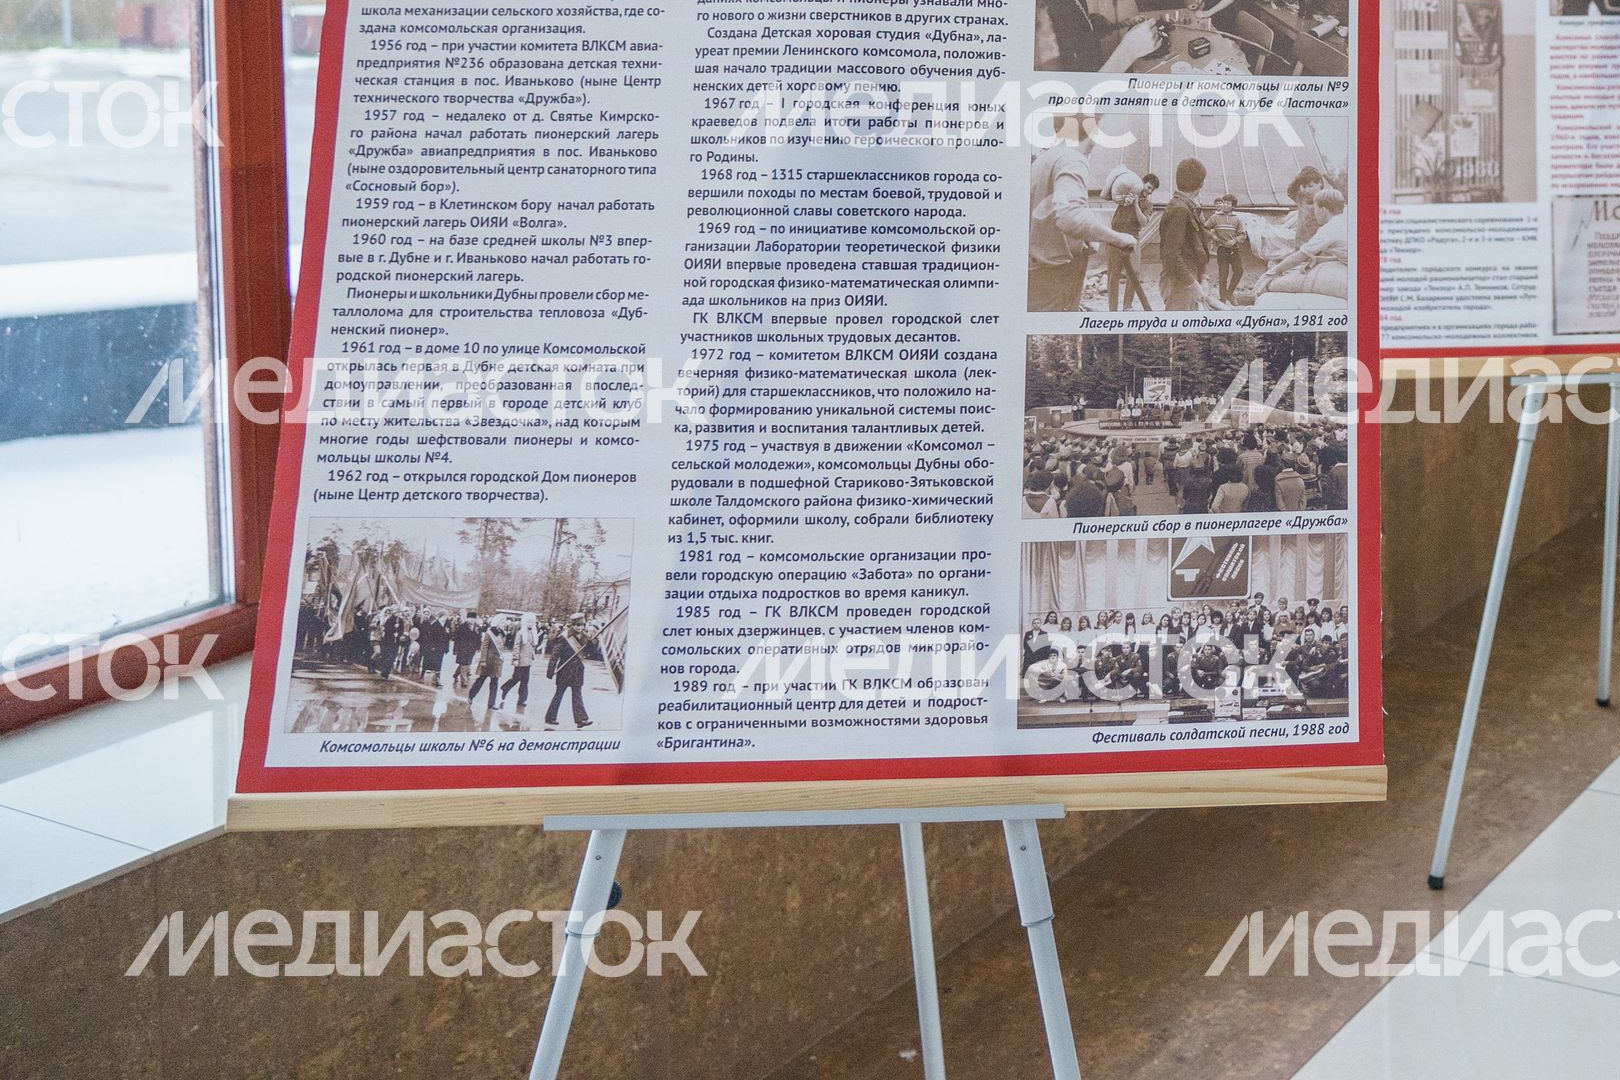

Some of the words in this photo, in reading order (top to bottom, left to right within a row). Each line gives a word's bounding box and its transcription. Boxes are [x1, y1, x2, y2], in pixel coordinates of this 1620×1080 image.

[356, 59, 440, 71] предприятия
[445, 57, 485, 69] №236
[489, 57, 564, 71] образована
[567, 60, 617, 70] детская
[621, 60, 663, 69] техни-
[355, 77, 398, 86] ческая
[403, 77, 455, 87] станция
[461, 77, 468, 86] в
[474, 77, 499, 86] пос.
[505, 75, 574, 87] Иваньково
[580, 75, 618, 89] (ныне
[623, 75, 662, 89] Центр
[1127, 77, 1183, 92] Пионеры
[1197, 82, 1280, 93] комсомольцы
[1283, 83, 1324, 92] школы
[1326, 81, 1349, 92] №9
[1047, 94, 1112, 107] проводят
[1113, 95, 1169, 107] занятие
[1170, 97, 1179, 107] в
[1182, 96, 1235, 108] детском
[1079, 317, 1124, 331] Лагерь
[1127, 316, 1167, 331] труда
[1170, 319, 1179, 328] и
[1182, 316, 1232, 328] отдыха
[1235, 315, 1290, 330] «Дубна»,
[1293, 314, 1323, 326] 1981
[1327, 314, 1348, 326] год
[671, 479, 734, 491] рудовали
[738, 479, 746, 488] в
[750, 476, 830, 491] подшефной
[834, 474, 994, 491] Стариково-Зятьковской
[313, 488, 354, 503] (ныне
[358, 488, 400, 503] Центр
[402, 491, 463, 502] детского
[465, 489, 549, 504] творчества).
[668, 513, 725, 527] кабинет,
[728, 513, 799, 528] оформили
[804, 516, 850, 528] школу,
[854, 513, 909, 528] собрали
[915, 512, 994, 526] библиотеку
[1072, 520, 1149, 536] Пионерский
[1152, 519, 1181, 534] сбор
[1184, 522, 1192, 531] в
[1195, 519, 1282, 532] пионерлагере
[1285, 514, 1348, 530] «Дружба»
[1092, 731, 1166, 744] Фестиваль
[1169, 726, 1246, 741] солдатской
[1249, 727, 1289, 738] песни,
[1292, 723, 1325, 736] 1988
[1328, 721, 1350, 735] год
[319, 740, 416, 754] Комсомольцы
[418, 742, 466, 752] школы
[468, 739, 495, 752] №6
[497, 742, 515, 751] на
[518, 738, 621, 754] демонстрации
